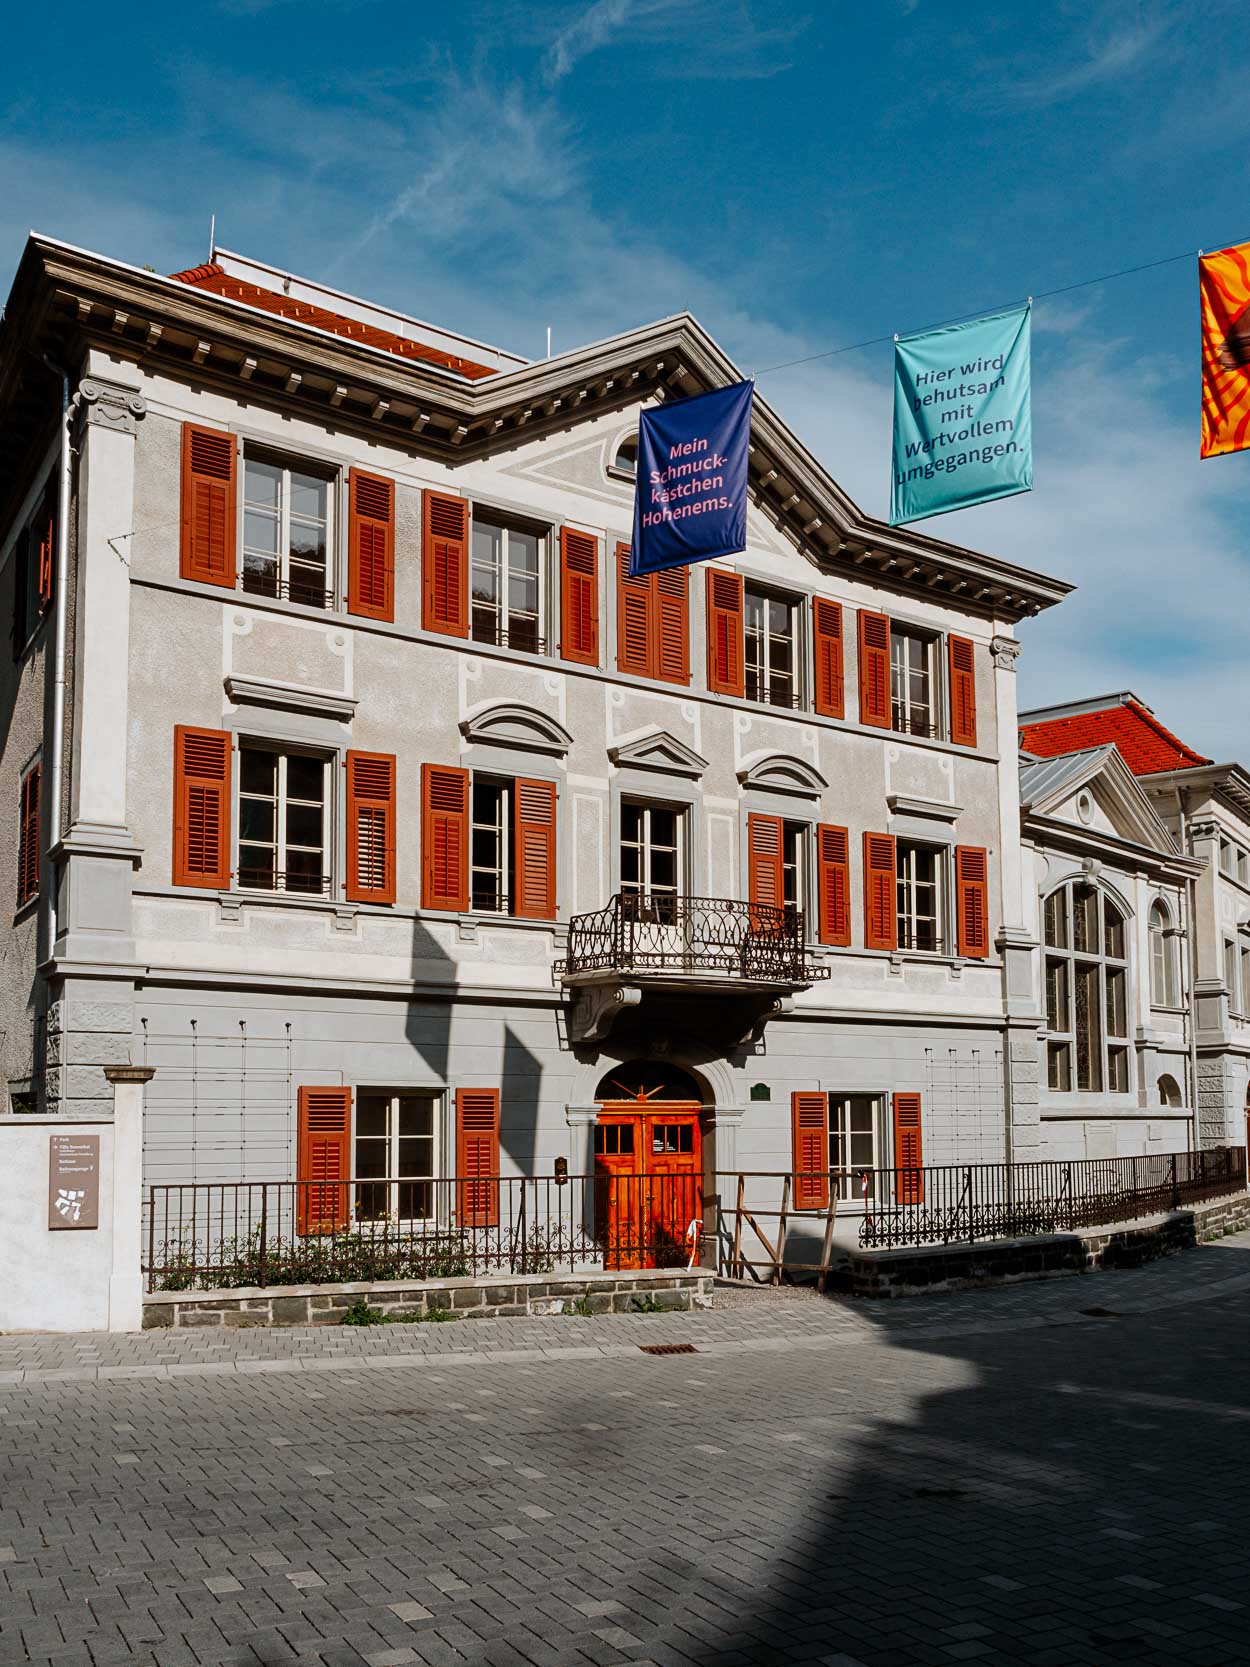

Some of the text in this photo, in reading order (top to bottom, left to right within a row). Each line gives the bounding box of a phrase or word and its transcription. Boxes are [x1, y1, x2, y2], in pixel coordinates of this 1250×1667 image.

[915, 354, 1004, 388] Hier wird
[913, 375, 1005, 411] behutsam
[941, 403, 974, 424] mit
[669, 438, 708, 460] Mein
[905, 417, 1014, 459] Wertvollem
[649, 453, 728, 485] Schmuck-
[896, 439, 1024, 486] umgegangen.
[651, 475, 723, 505] kästchen
[642, 496, 733, 529] Hohenems.
